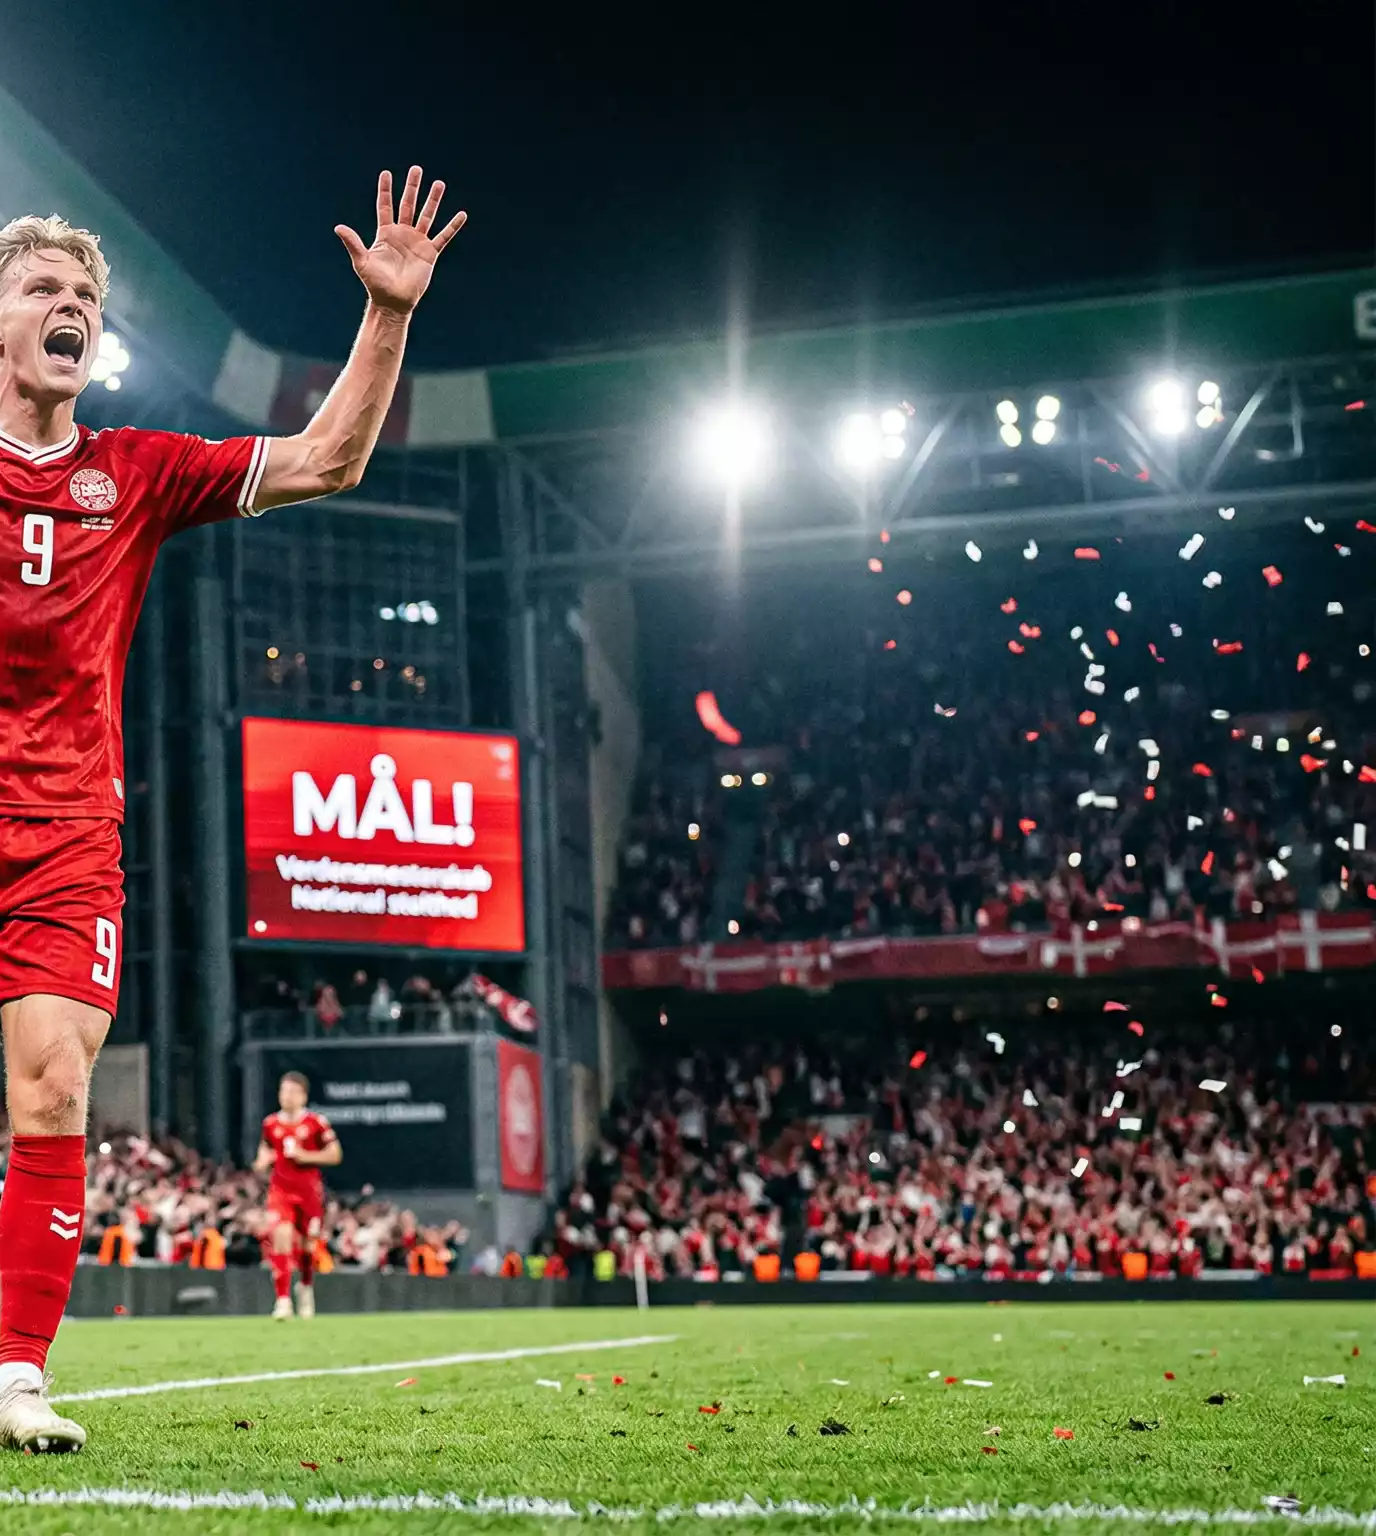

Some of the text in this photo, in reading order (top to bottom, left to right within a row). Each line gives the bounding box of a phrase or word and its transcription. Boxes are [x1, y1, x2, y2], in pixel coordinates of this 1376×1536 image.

[21, 513, 54, 586] 9
[292, 753, 475, 847] MÅL!
[91, 917, 117, 990] 9
